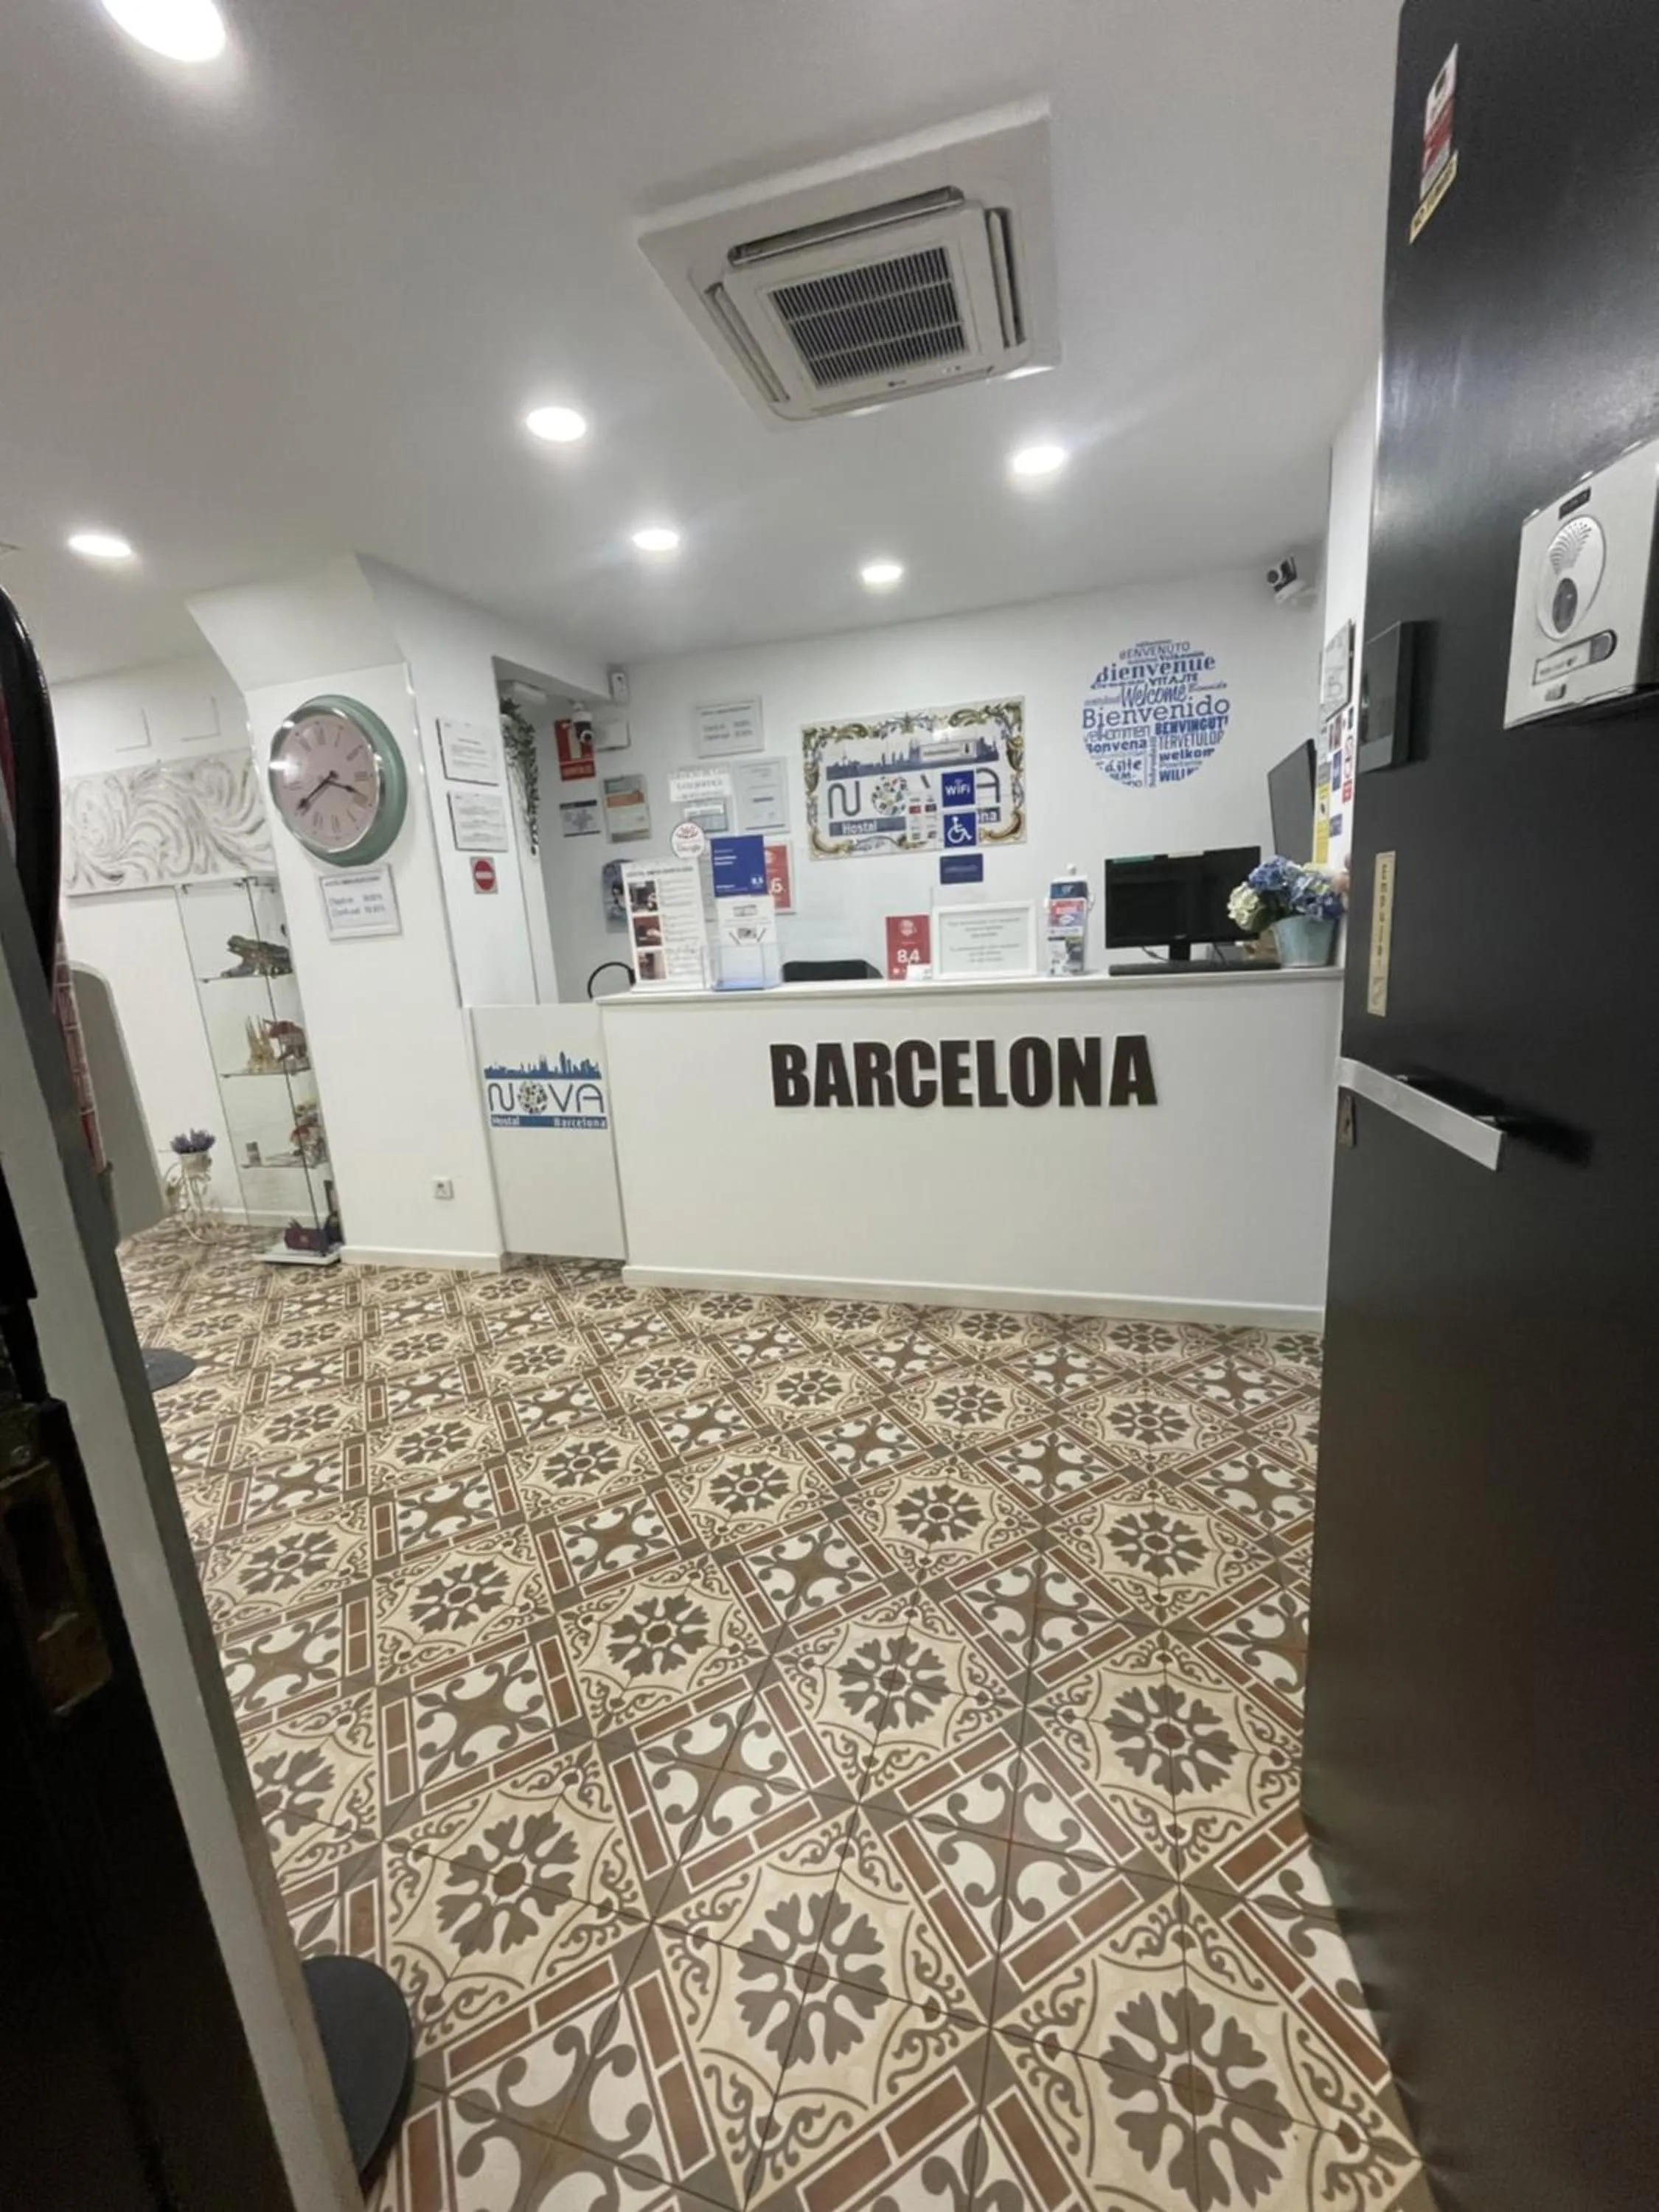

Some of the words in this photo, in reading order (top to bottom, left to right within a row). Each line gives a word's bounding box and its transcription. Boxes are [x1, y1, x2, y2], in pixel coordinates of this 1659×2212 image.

[1082, 695, 1230, 729] Bienvenido
[841, 819, 877, 836] Hostal
[770, 1034, 1158, 1108] BARCELONA
[487, 1081, 605, 1114] NOVA
